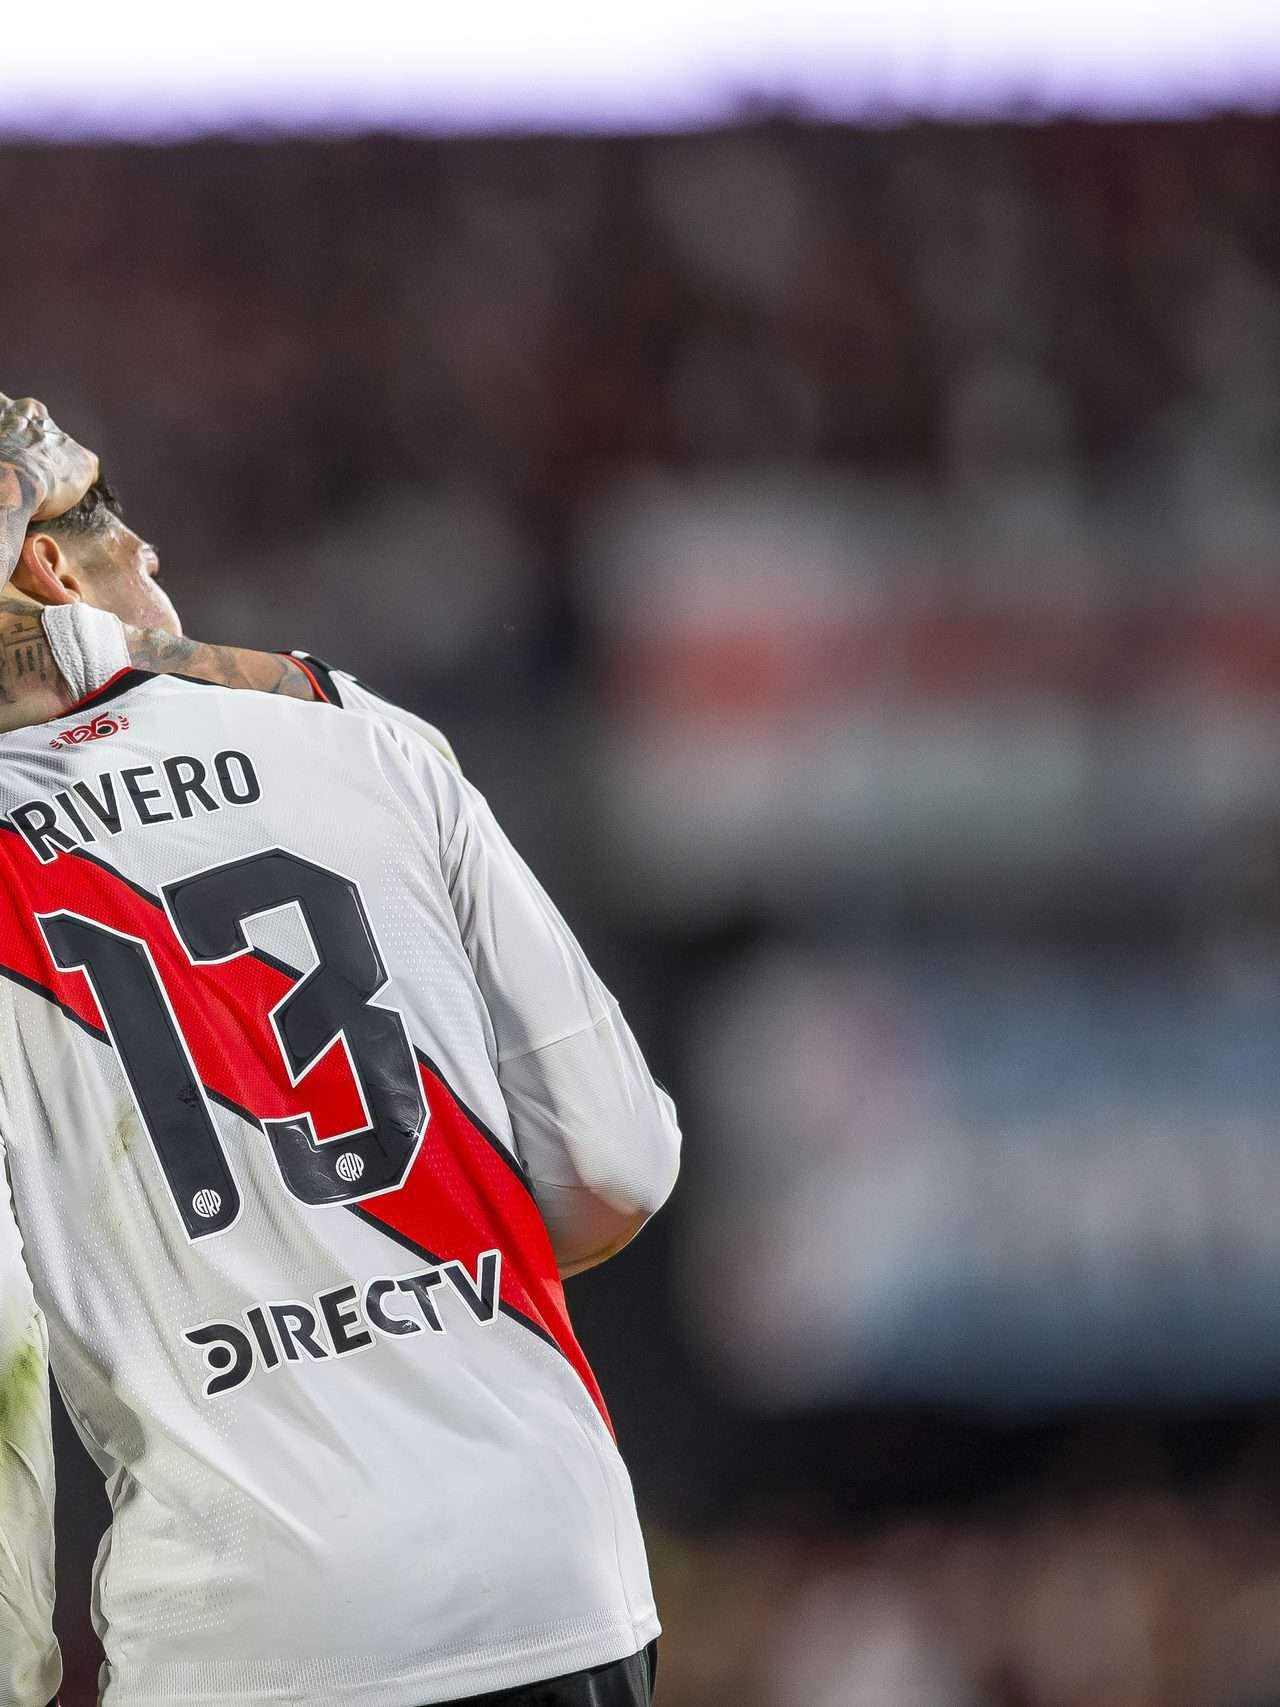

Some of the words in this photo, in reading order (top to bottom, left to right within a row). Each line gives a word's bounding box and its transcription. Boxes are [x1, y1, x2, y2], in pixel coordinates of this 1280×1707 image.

[7, 750, 261, 864] RIVERO
[35, 846, 430, 1243] 13
[192, 1188, 221, 1218] CARP
[335, 1152, 365, 1182] CARP
[184, 1249, 501, 1399] DIRECTV
